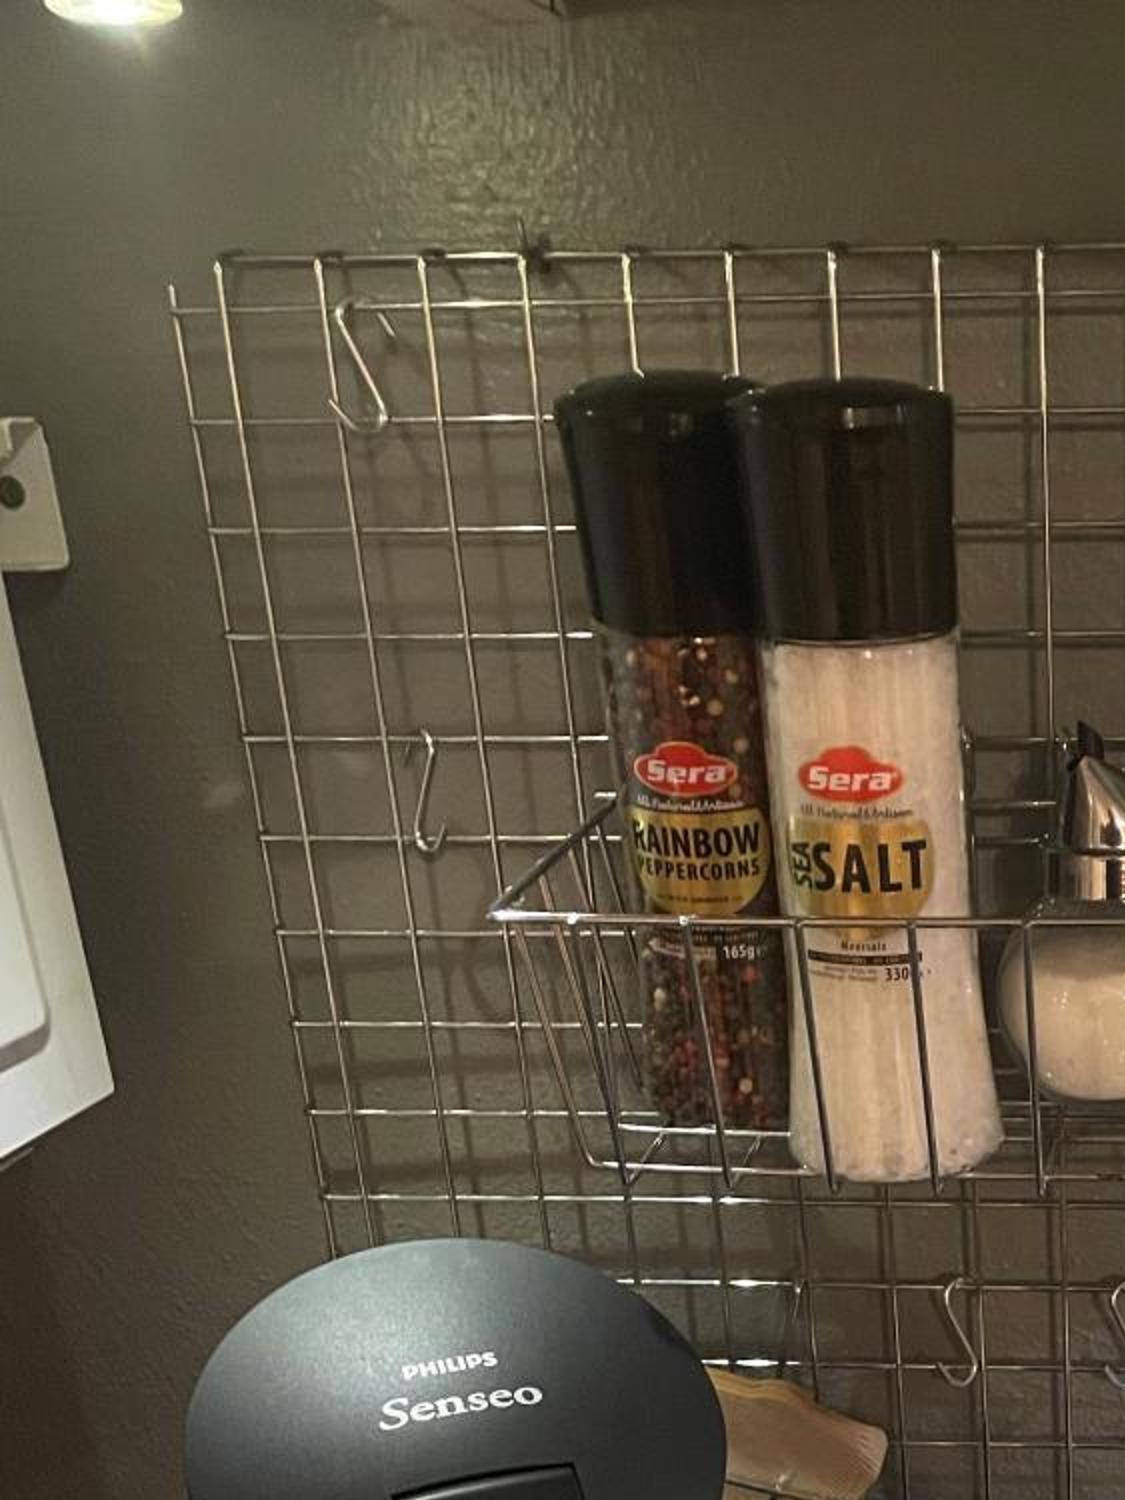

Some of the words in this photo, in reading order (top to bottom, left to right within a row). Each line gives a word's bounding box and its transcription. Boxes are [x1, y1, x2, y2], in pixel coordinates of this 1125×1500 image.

[647, 759, 726, 785] Sera
[808, 764, 893, 792] Sera
[632, 822, 760, 859] RAINBOW
[812, 838, 927, 893] SALT
[401, 1351, 498, 1381] PHILIPS
[378, 1386, 544, 1431] Senseo
